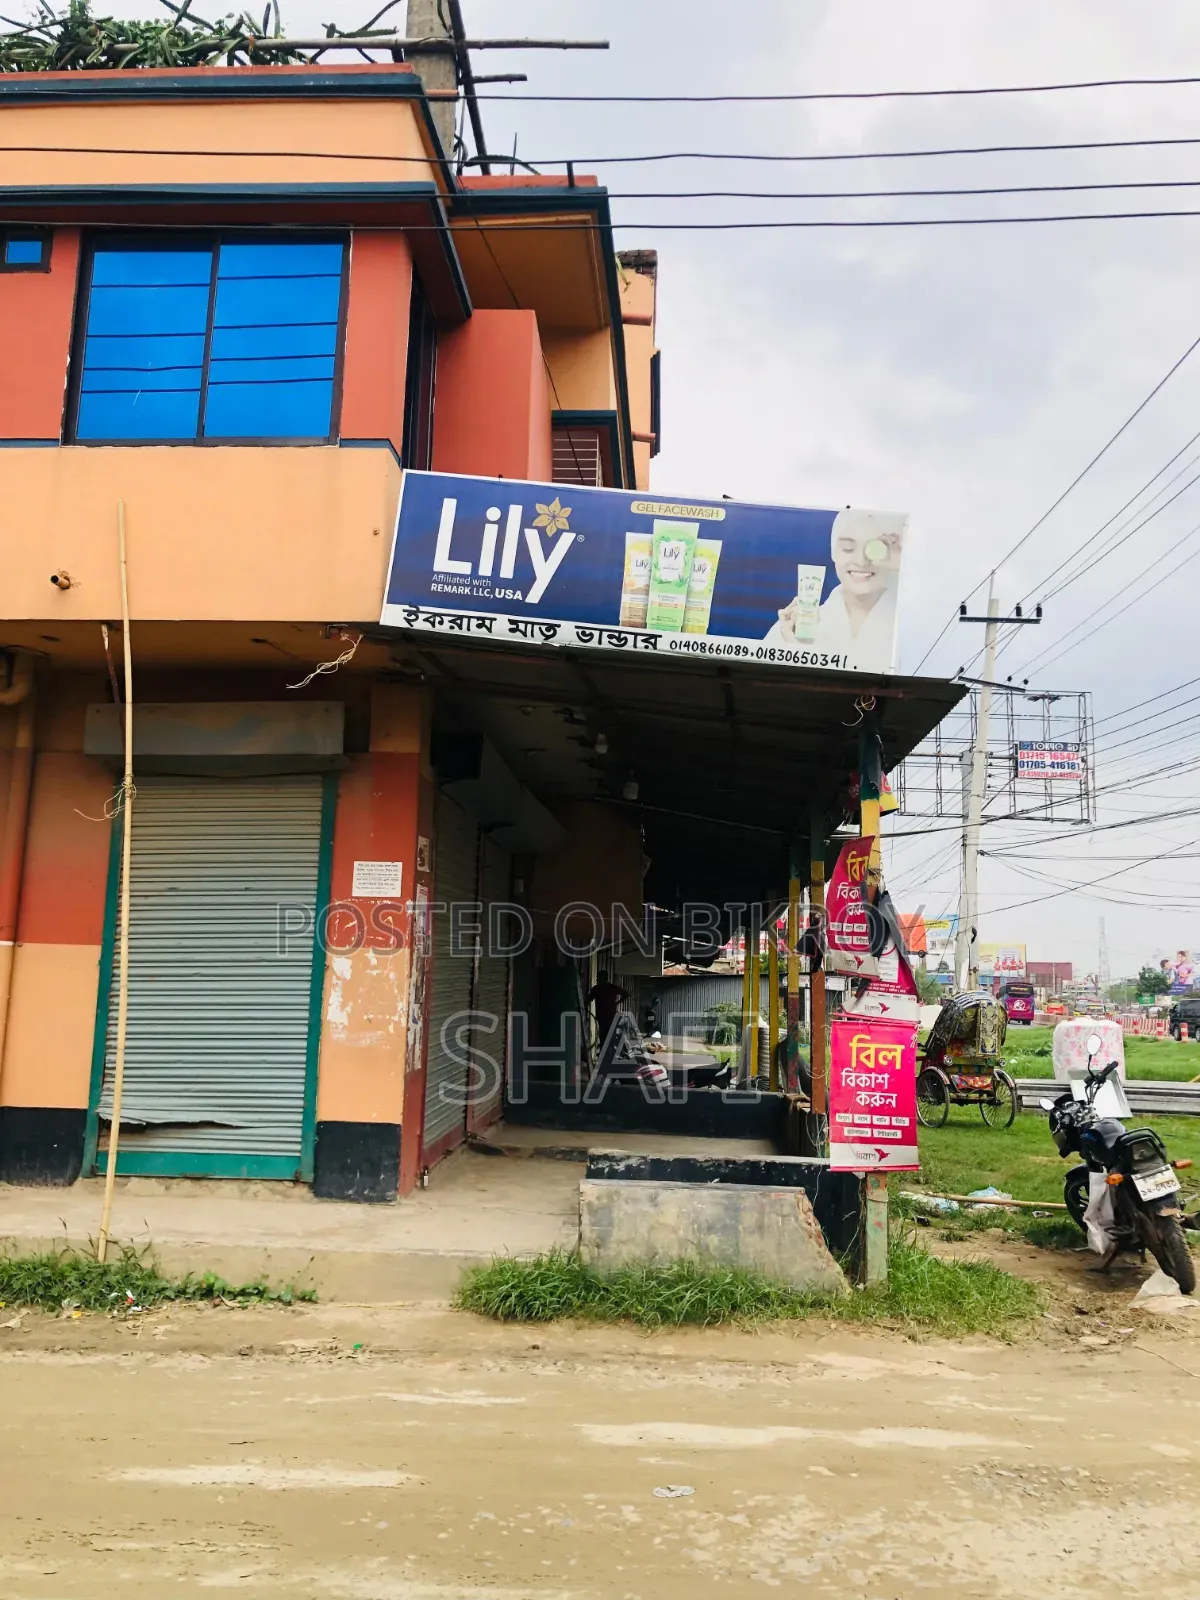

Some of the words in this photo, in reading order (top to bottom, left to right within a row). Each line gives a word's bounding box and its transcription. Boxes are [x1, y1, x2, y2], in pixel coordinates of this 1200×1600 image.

[636, 503, 657, 513] GEL
[658, 504, 720, 518] FACEWASH
[433, 498, 576, 604] Lily
[663, 547, 681, 559] Lily
[693, 563, 707, 574] Lily
[431, 573, 471, 585] Affiliated
[472, 578, 492, 587] with
[430, 583, 472, 595] REMARK
[473, 587, 494, 599] LLC,
[495, 587, 523, 601] USA
[402, 605, 497, 633] ইকরাম
[575, 625, 663, 650] ভান্ডার
[849, 1034, 905, 1070] বিল
[841, 1068, 890, 1089] বিকাশ
[855, 1091, 897, 1108] করুন
